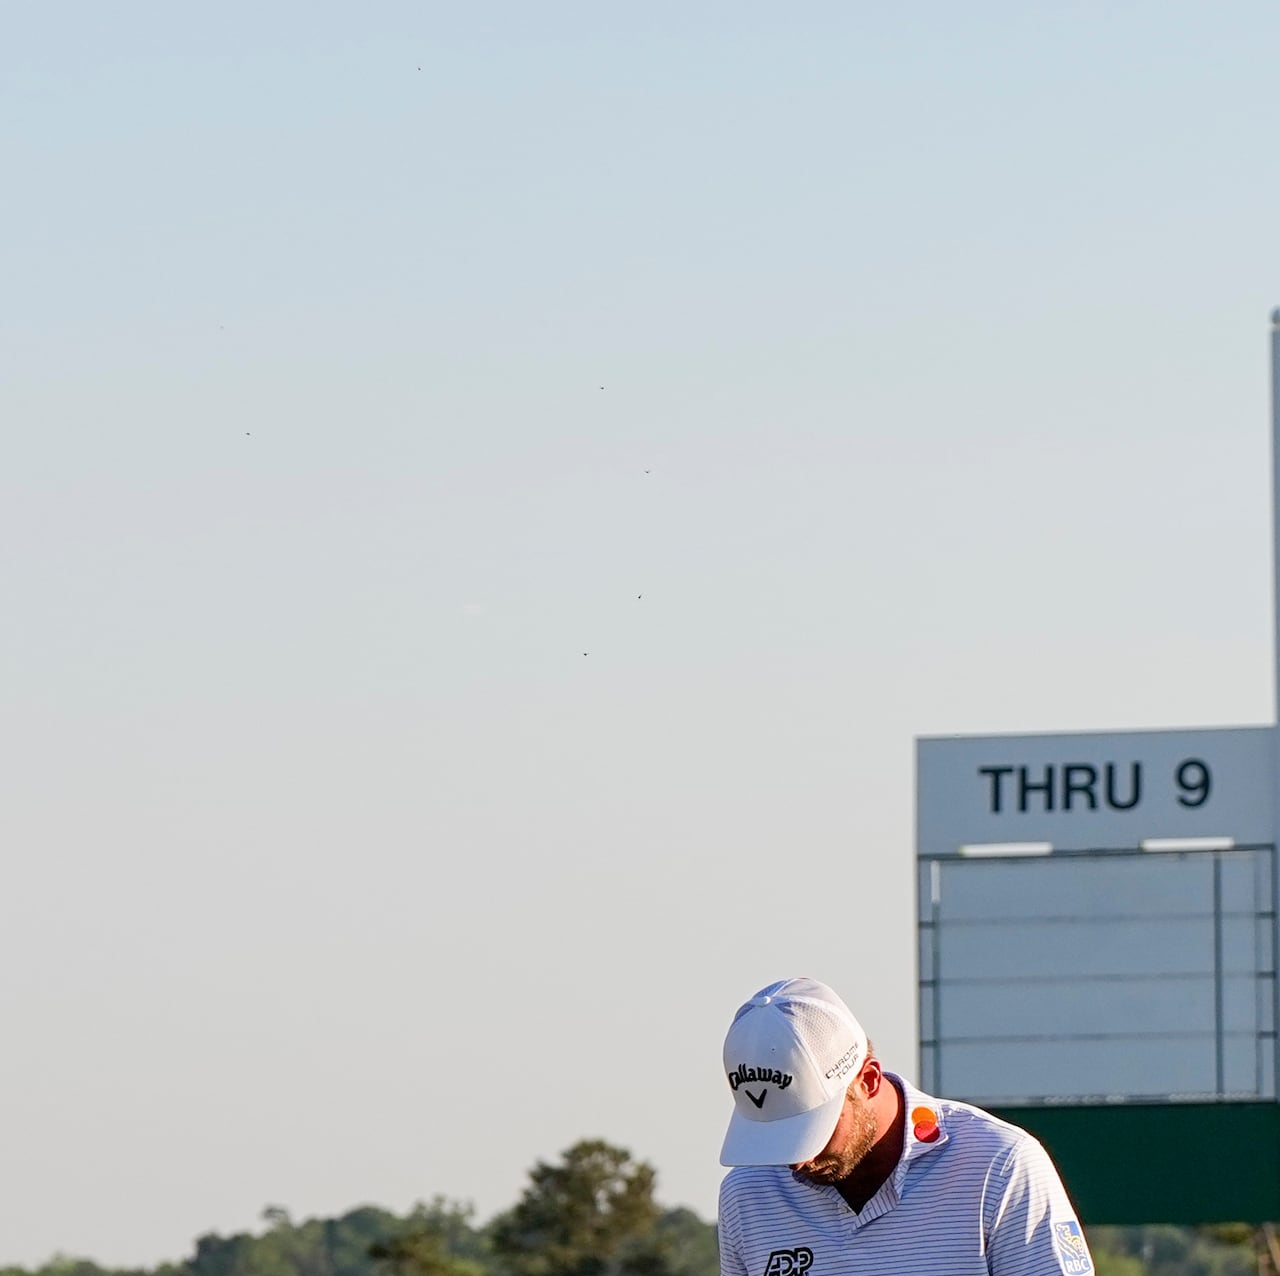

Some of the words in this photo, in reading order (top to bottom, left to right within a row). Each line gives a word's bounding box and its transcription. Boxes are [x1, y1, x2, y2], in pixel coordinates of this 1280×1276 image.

[978, 761, 1143, 815] THRU
[1175, 759, 1211, 809] 9
[728, 1063, 793, 1090] Callaway
[1065, 1257, 1091, 1273] RBC
